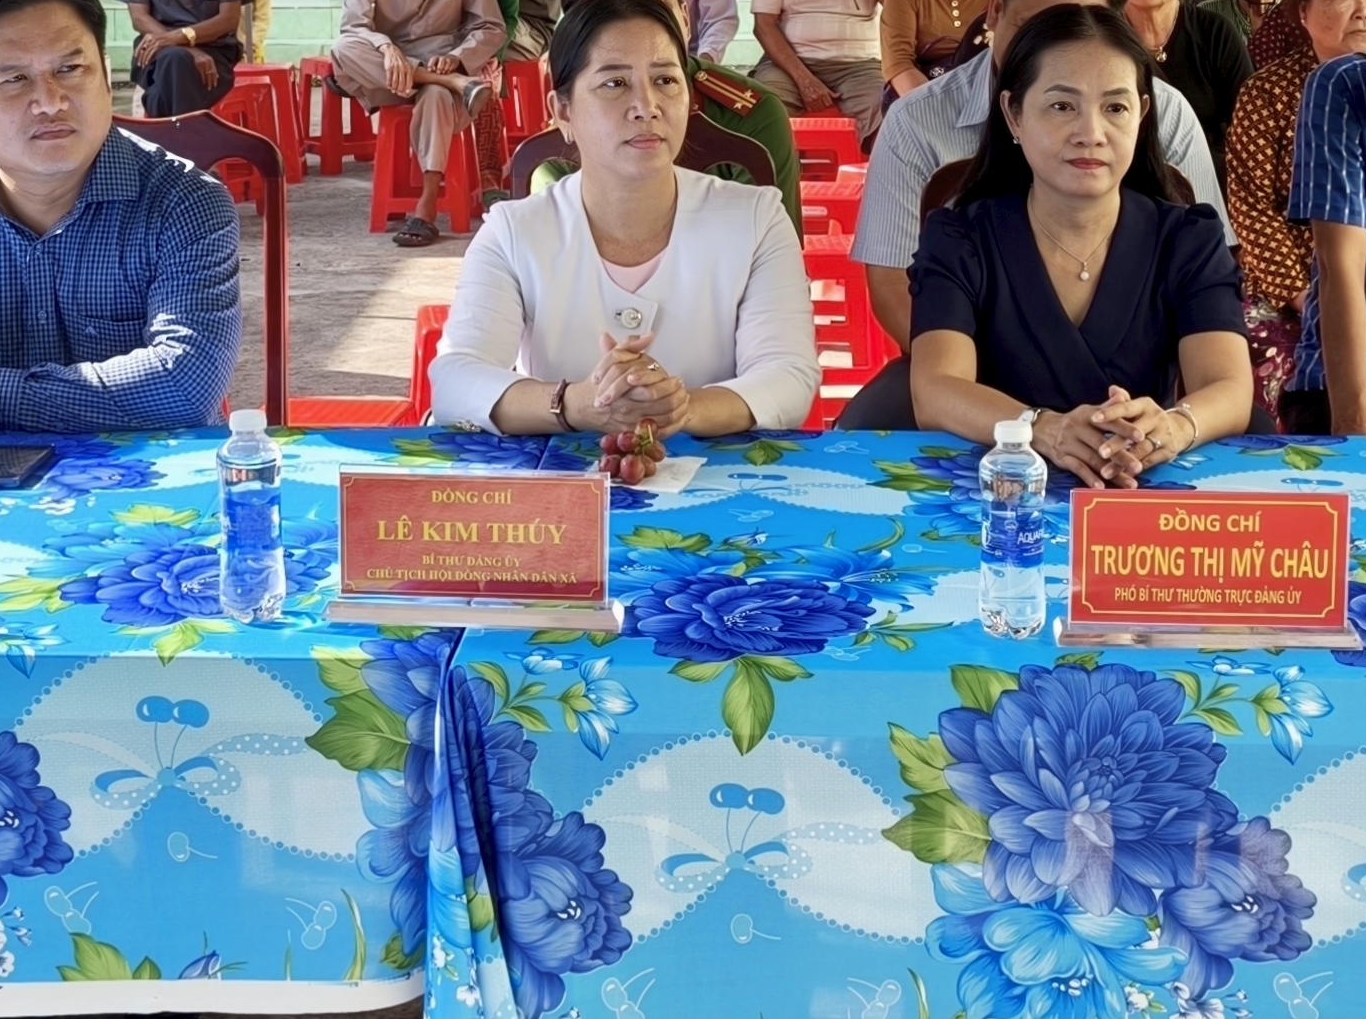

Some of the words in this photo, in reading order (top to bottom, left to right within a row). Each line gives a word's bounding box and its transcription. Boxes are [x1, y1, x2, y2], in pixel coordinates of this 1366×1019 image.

[483, 489, 512, 504] CHÍ
[376, 515, 413, 541] LÊ
[421, 521, 479, 542] KIM
[487, 518, 566, 544] THÚY
[1159, 507, 1220, 532] ĐỒNG
[1226, 511, 1261, 532] CHÍ
[437, 555, 465, 566] THƯ
[1091, 543, 1185, 576] TRƯƠNG
[1191, 547, 1225, 583] THỊ
[1231, 541, 1265, 578] MỸ
[1270, 541, 1329, 579] CHÂU
[396, 569, 426, 583] TỊCH
[429, 569, 453, 583] HỘI
[493, 569, 530, 583] NHÂN
[532, 570, 558, 584] DÂN
[560, 572, 578, 584] XÃ
[1115, 584, 1136, 602] PHÓ
[1139, 585, 1149, 602] BÍ
[1152, 587, 1175, 602] THƯ
[1176, 585, 1222, 603] THƯỜNG
[1224, 588, 1252, 606] TRỰC
[1254, 585, 1285, 604] ĐẢNG
[1287, 586, 1302, 604] ỦY
